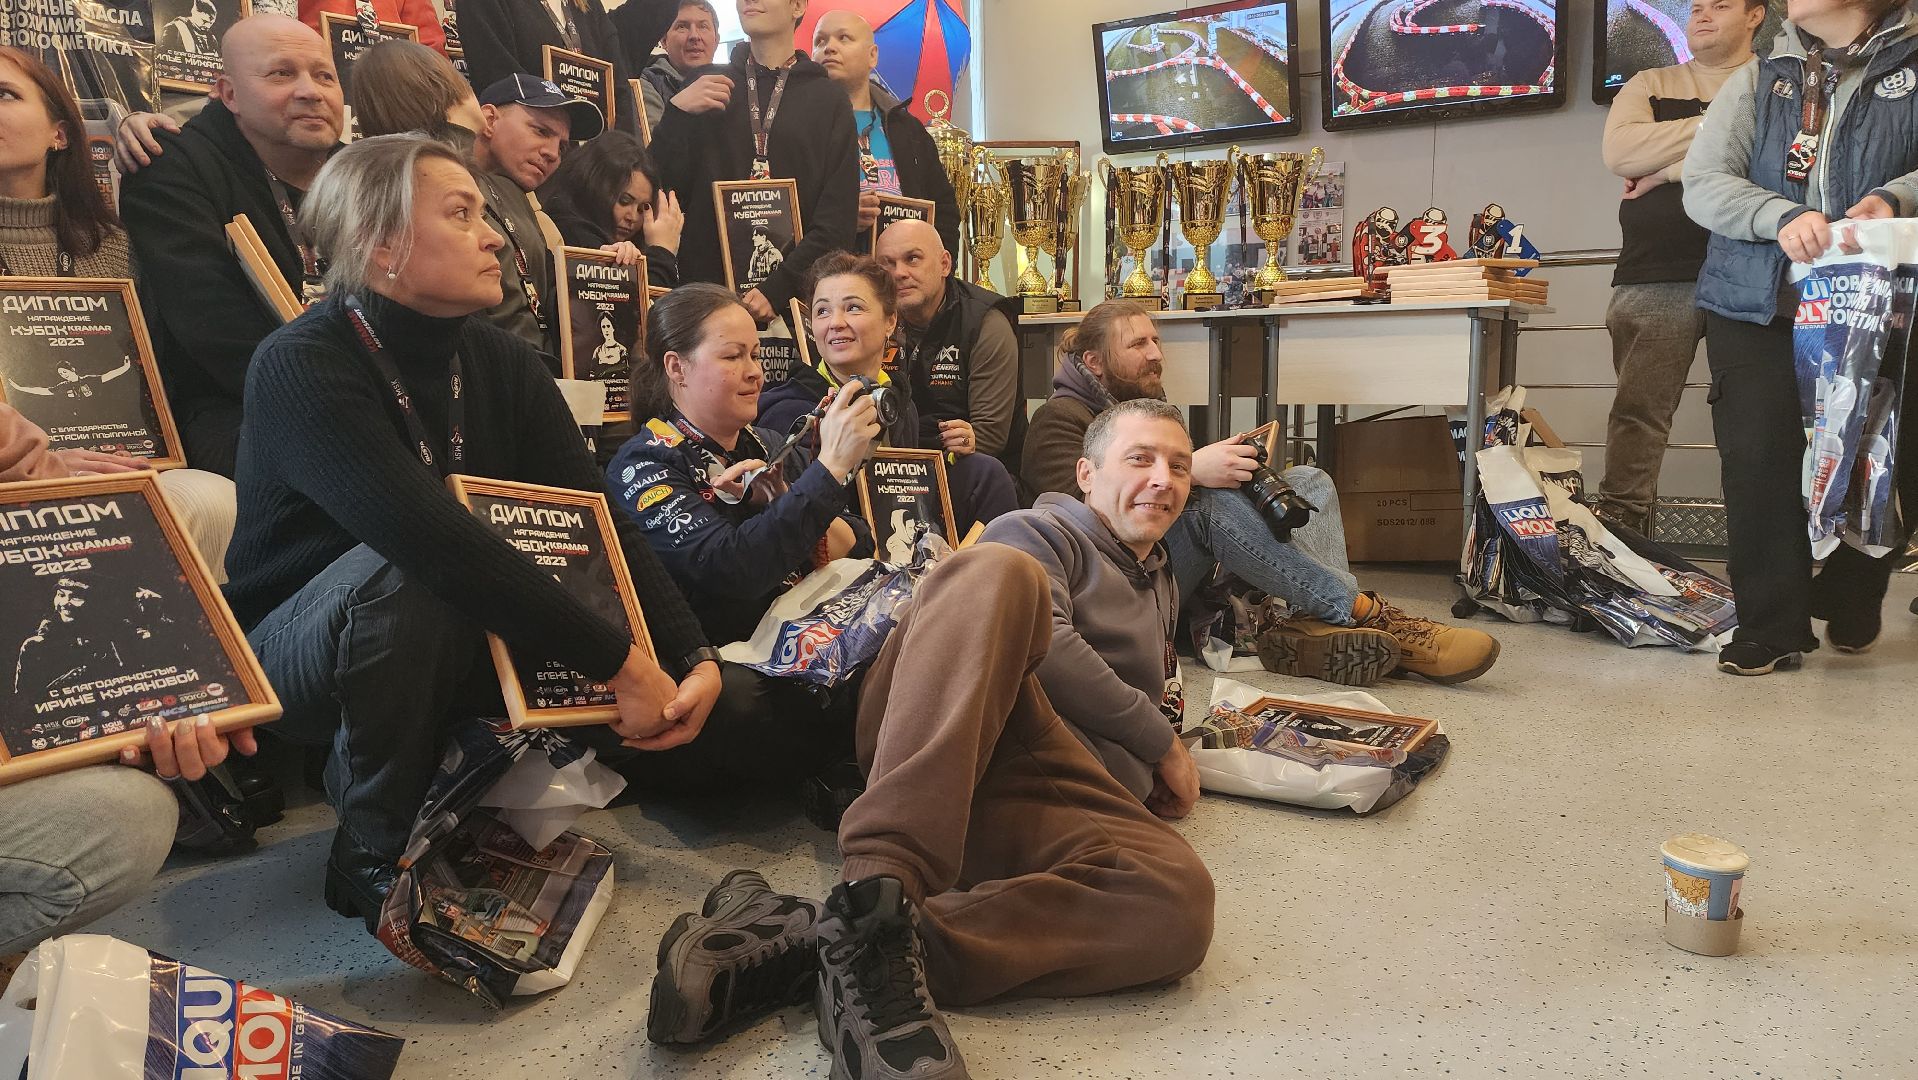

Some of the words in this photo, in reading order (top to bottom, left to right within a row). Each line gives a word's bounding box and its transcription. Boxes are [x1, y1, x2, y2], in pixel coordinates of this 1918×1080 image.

[0, 11, 86, 33] ВТОХИМИЯ
[0, 29, 133, 57] ВТОКОСМЕТИКА
[559, 62, 599, 83] ДИПЛОМ
[731, 190, 781, 205] ДИПЛОМ
[733, 210, 760, 219] КУБОК
[883, 205, 922, 219] ДИПЛОМ
[751, 218, 768, 226] 2023
[1414, 224, 1449, 256] 3
[1506, 223, 1525, 255] 1
[576, 263, 630, 282] ДИПЛОМ
[578, 290, 607, 301] КУБОК
[2, 295, 108, 314] ДИПЛОМ
[596, 302, 615, 311] 2023
[27, 315, 92, 323] НАГРАЖДЕНИЕ
[10, 325, 69, 336] КУБОК
[48, 337, 85, 347] 2023
[874, 462, 928, 476] ДИПЛОМ
[623, 469, 669, 501] RENAULT
[877, 485, 907, 494] КУБОК
[643, 487, 669, 504] RAUCH
[896, 495, 916, 503] 2023
[490, 503, 584, 529] ДИПЛОМ
[645, 512, 665, 529] Pepe
[661, 494, 687, 517] Jeans
[513, 528, 571, 540] НАГРАЖДЕНИЕ
[671, 516, 709, 549] INFINITI
[1515, 520, 1557, 535] MOLY
[61, 535, 133, 552] KRAMAR
[549, 541, 590, 552] KRAMAR
[33, 557, 92, 576] 2023
[534, 554, 568, 567] 2023
[49, 689, 59, 698] С
[62, 665, 178, 695] БЛАГОДАРНОСТЬЮ
[34, 693, 97, 714] ИРИНЕ
[100, 668, 200, 700] КУРАНОВОЙ
[296, 1042, 304, 1058] IN
